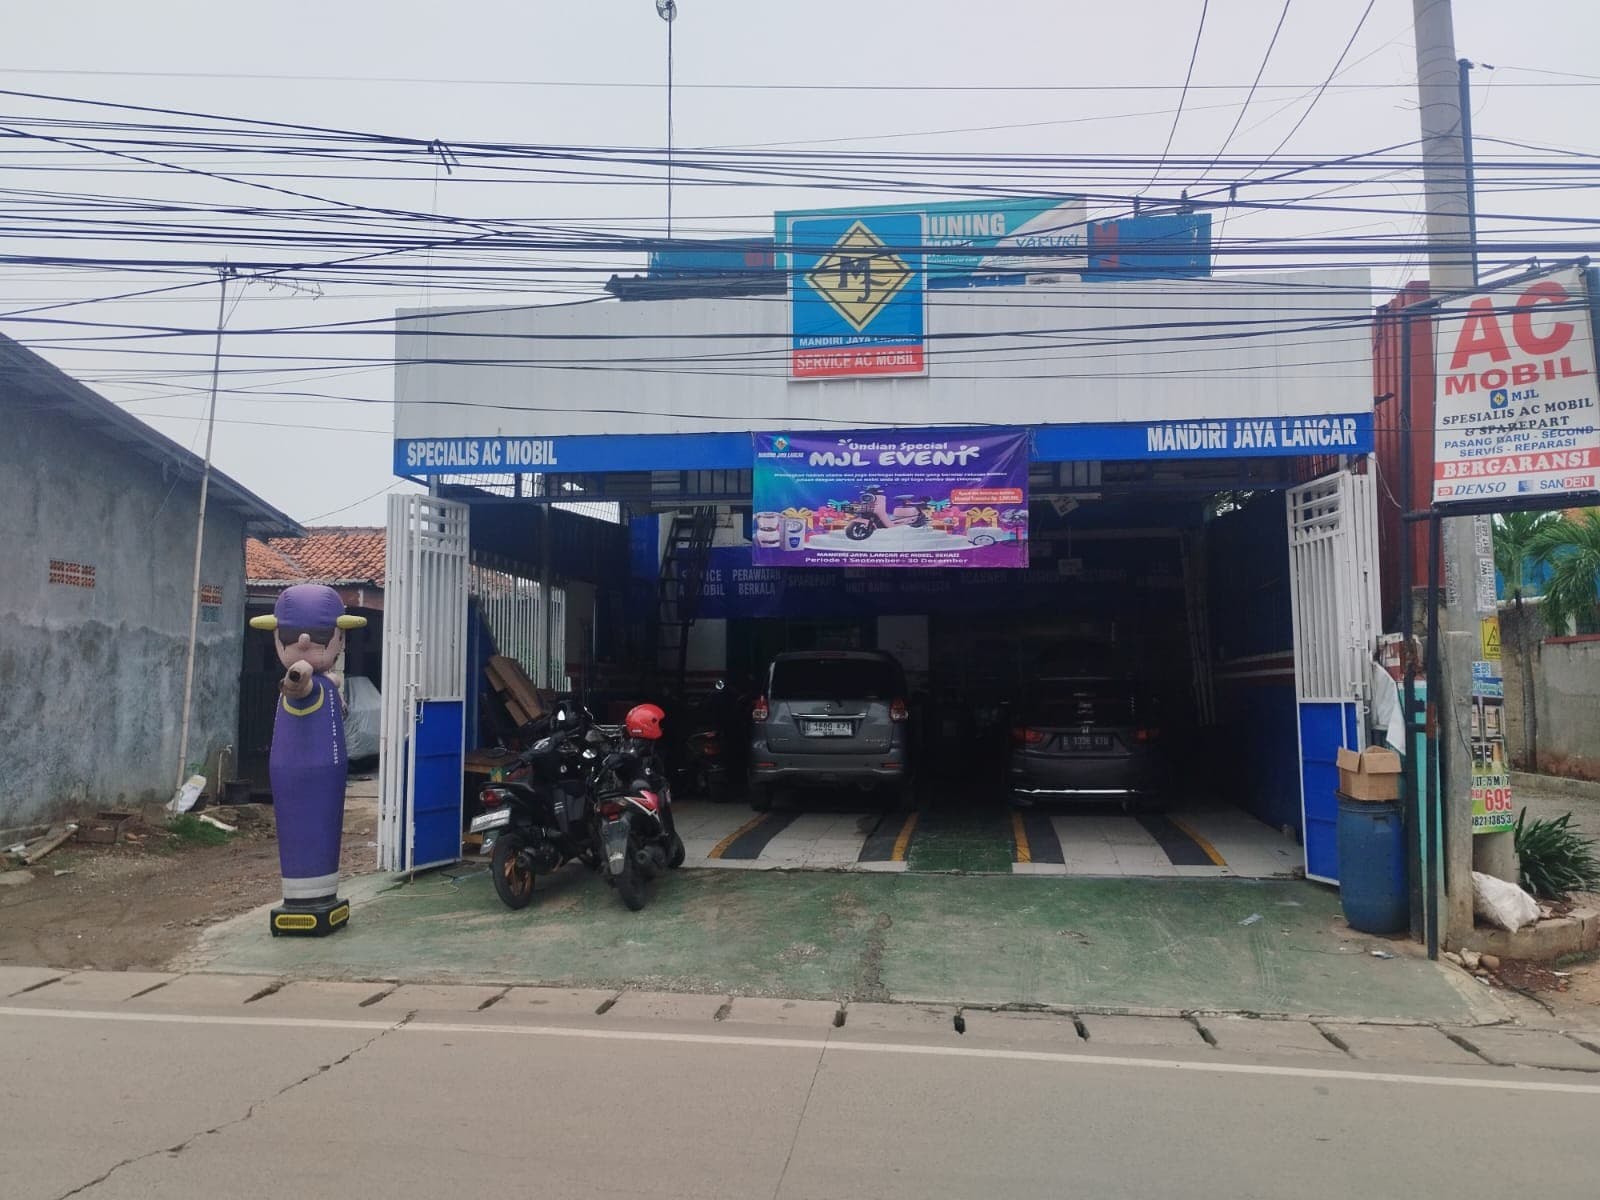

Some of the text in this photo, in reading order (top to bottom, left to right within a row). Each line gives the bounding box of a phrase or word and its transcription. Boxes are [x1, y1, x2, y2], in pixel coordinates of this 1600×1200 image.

[925, 213, 1004, 236] UNING
[1450, 281, 1574, 370] AC
[799, 336, 842, 346] MANDIRI
[796, 349, 917, 370] SERVICE AC MOBIL
[1445, 356, 1588, 395] MOBIL
[1511, 389, 1539, 401] MJL
[1442, 398, 1594, 425] SPESIALIS AC MOBIL
[1147, 418, 1357, 451] MANDIRI JAYA LANCAR
[1479, 416, 1570, 435] SPAREPART
[900, 441, 947, 452] Special
[1444, 437, 1493, 449] PASANG
[1497, 433, 1530, 443] BARU
[1542, 425, 1594, 438] SECOND
[1459, 446, 1504, 457] SERVIS
[1515, 438, 1576, 452] REPARASI
[407, 440, 558, 466] SPECIALIS AC MOBIL
[809, 447, 979, 466] MJL EVENT
[1443, 451, 1591, 478] BERGARANSI
[1454, 476, 1592, 495] DENSO SANDEN
[682, 569, 721, 581] SICE
[732, 568, 781, 581] PERAWATAN
[738, 583, 776, 596] BERKALA
[1485, 788, 1512, 812] 695
